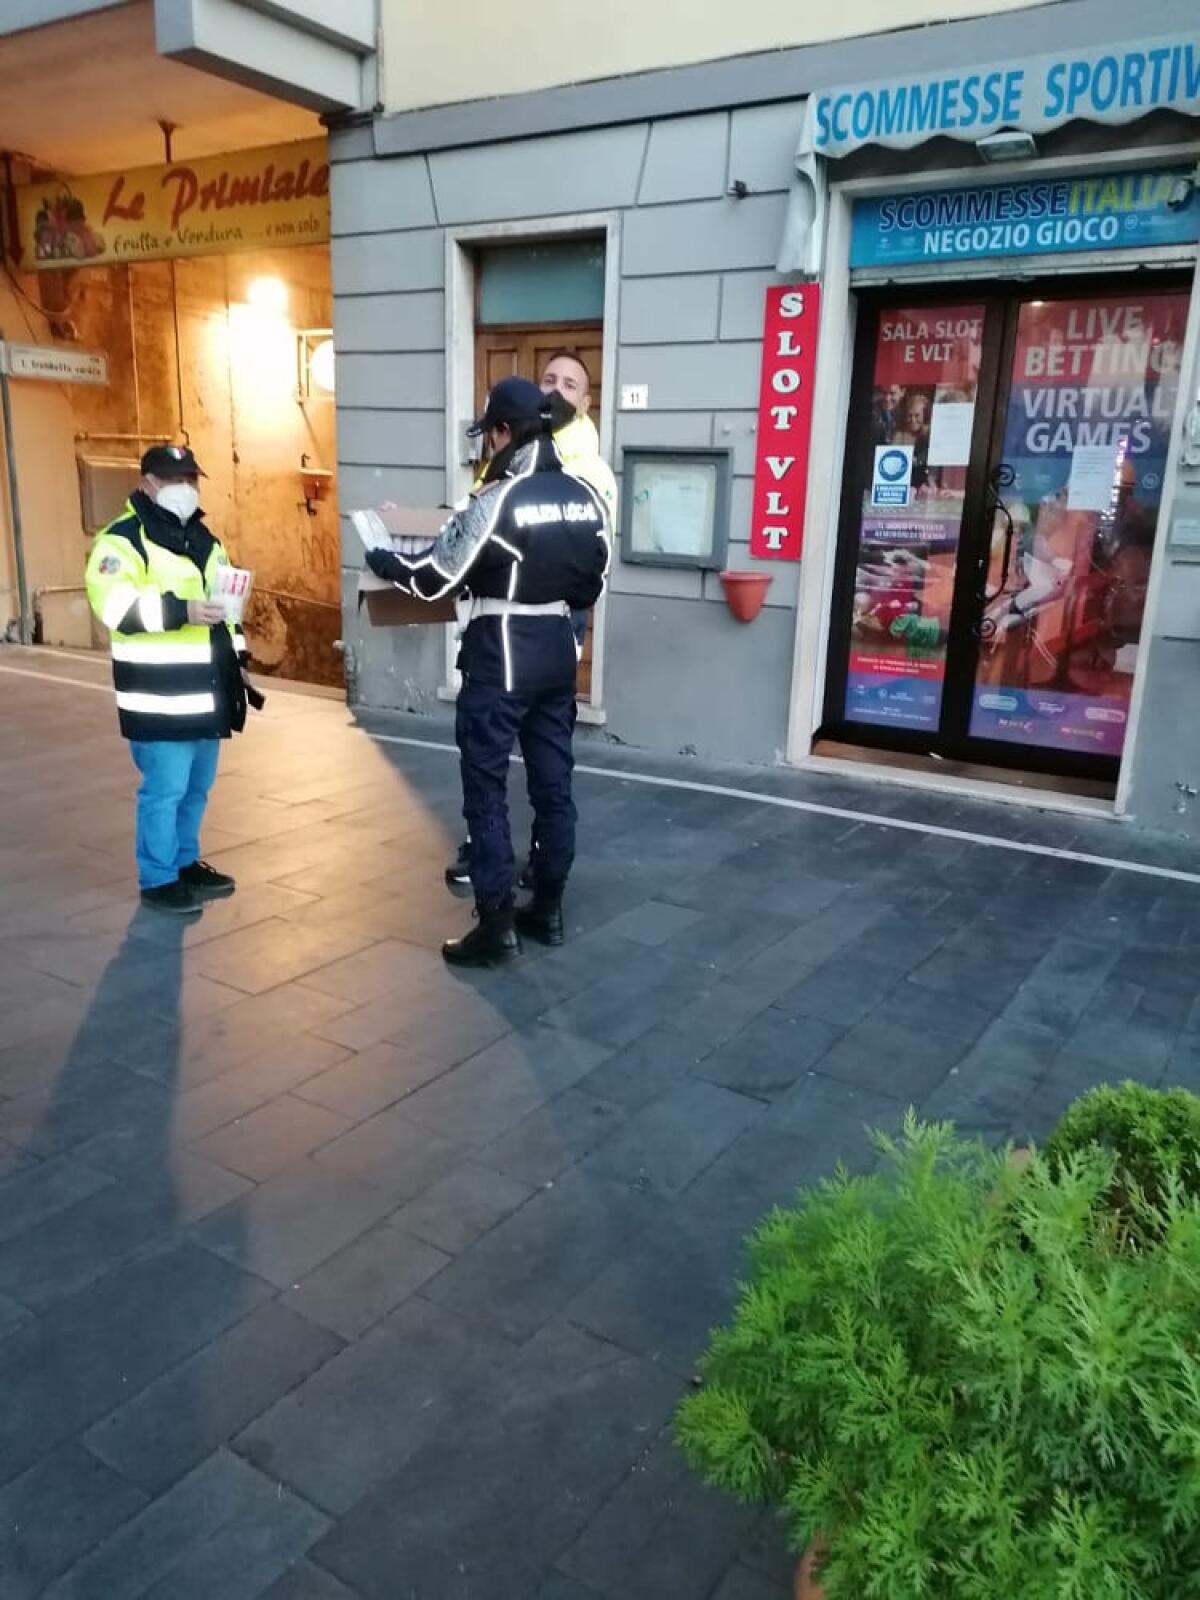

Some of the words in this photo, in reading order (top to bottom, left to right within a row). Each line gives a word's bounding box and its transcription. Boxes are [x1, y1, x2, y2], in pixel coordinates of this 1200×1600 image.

[815, 69, 1025, 146] SCOMMESSE
[1043, 44, 1200, 118] SPORTIV
[102, 175, 145, 227] Le
[176, 222, 244, 245] Verdura
[922, 221, 1031, 255] NEGOZIO
[1036, 214, 1119, 246] GIOCO
[882, 321, 930, 342] SALA
[934, 318, 984, 340] SLOT
[1066, 306, 1146, 341] LIVE
[770, 292, 805, 431] SLOT
[904, 344, 916, 363] E
[921, 343, 953, 362] VLT
[1023, 339, 1183, 378] BETTING
[1023, 387, 1171, 419] VIRTUAL
[1025, 421, 1153, 454] GAMES
[761, 456, 796, 551] VLT
